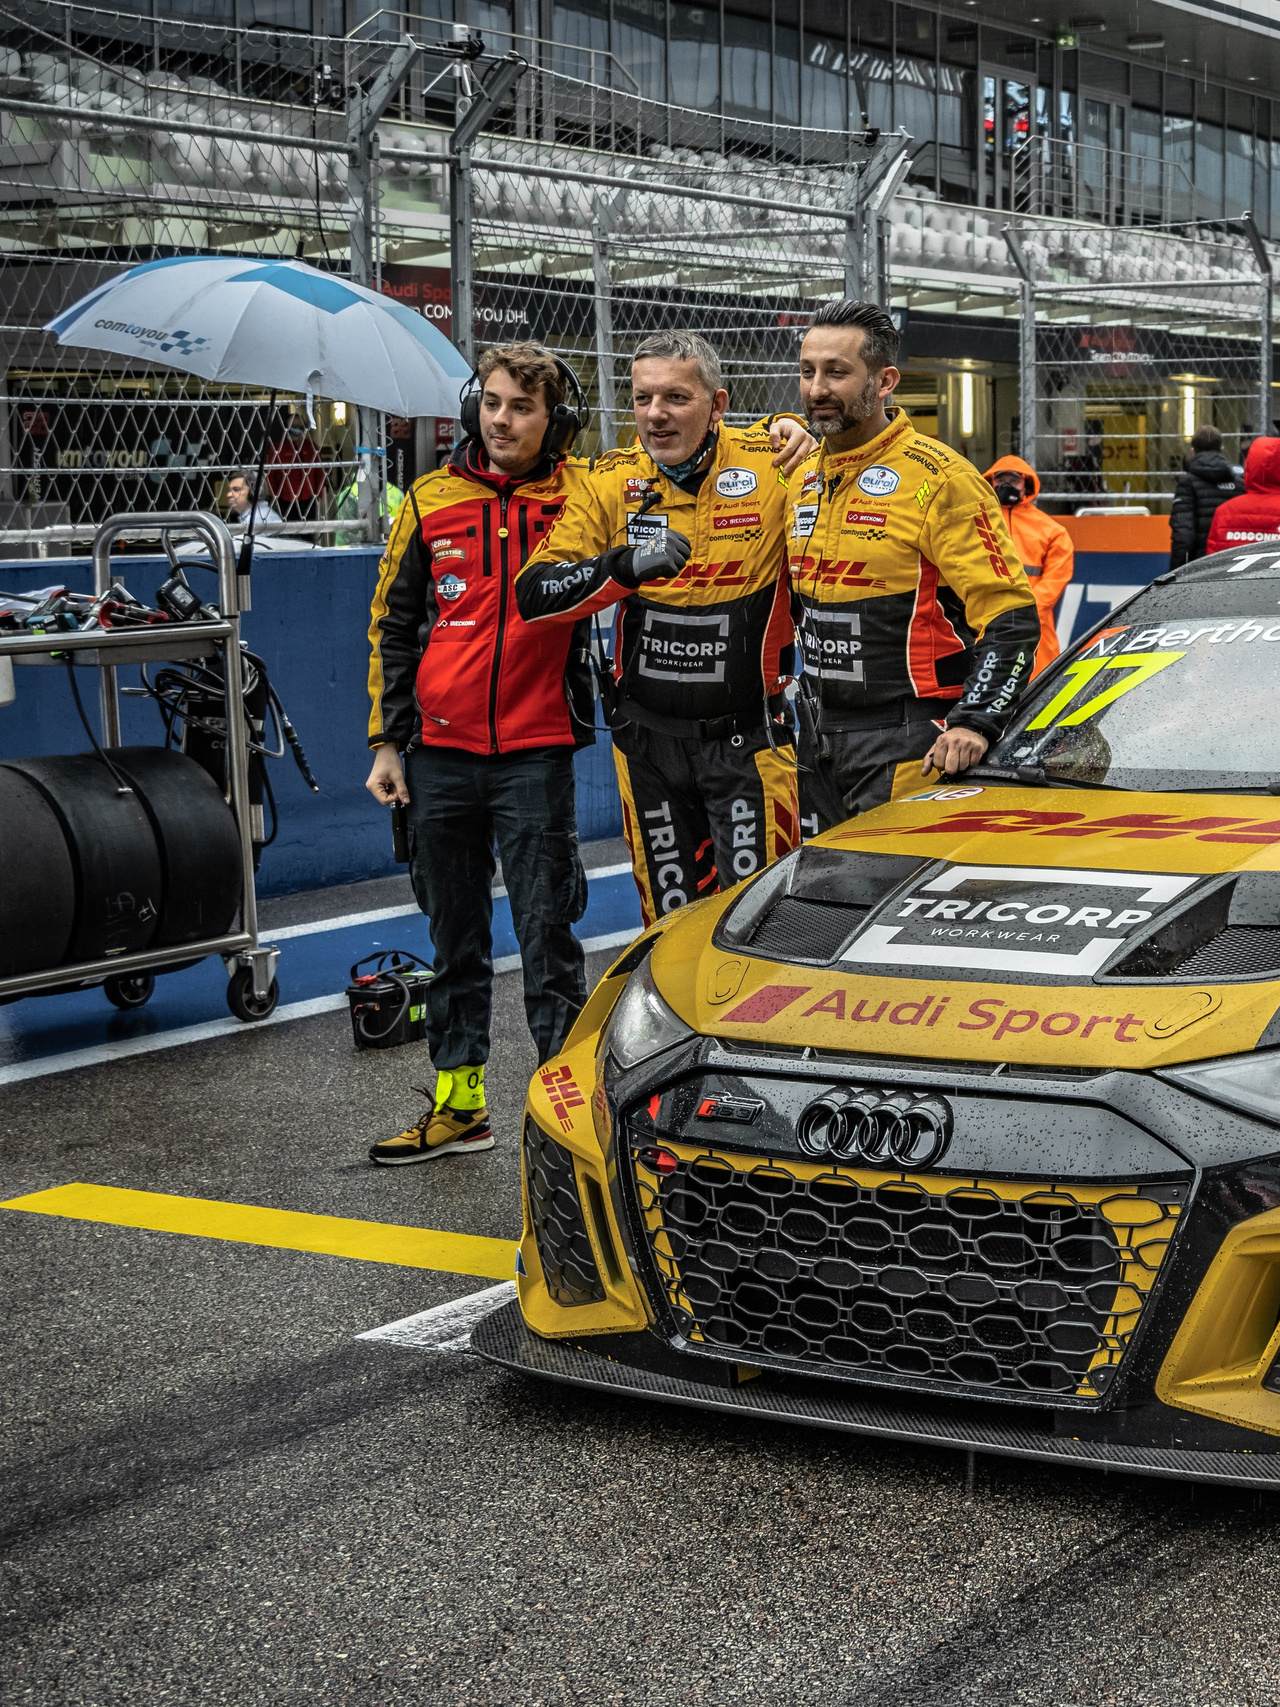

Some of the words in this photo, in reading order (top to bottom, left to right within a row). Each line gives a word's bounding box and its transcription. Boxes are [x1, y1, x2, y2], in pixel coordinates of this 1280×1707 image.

[382, 281, 418, 297] Audi
[423, 283, 452, 303] Spo
[424, 303, 503, 323] COMYOU
[507, 309, 529, 325] DHL
[94, 319, 170, 341] comtoyou
[835, 452, 867, 467] DHL
[1102, 443, 1139, 460] ort
[903, 450, 940, 476] 4-BRANDS
[719, 477, 753, 489] eurol
[861, 476, 894, 489] eurol
[741, 500, 761, 509] Sport
[858, 498, 873, 506] Audi
[874, 499, 891, 508] Sport
[729, 516, 759, 525] IRECKONU
[628, 525, 662, 535] TRICOR
[709, 532, 744, 542] comtoyou
[840, 529, 868, 538] comtoyou
[541, 566, 595, 595] TRICOR
[790, 556, 874, 588] DHL
[443, 584, 459, 593] ASC
[642, 635, 728, 656] TRICORP
[654, 658, 704, 668] WORKWEAR
[1026, 651, 1188, 732] 17
[643, 800, 690, 914] TRICO
[902, 897, 1153, 928] TRICORP
[930, 926, 1062, 944] WORKWEAR
[801, 988, 953, 1029] Audi
[973, 997, 1146, 1043] Sport
[541, 1064, 586, 1121] DHL
